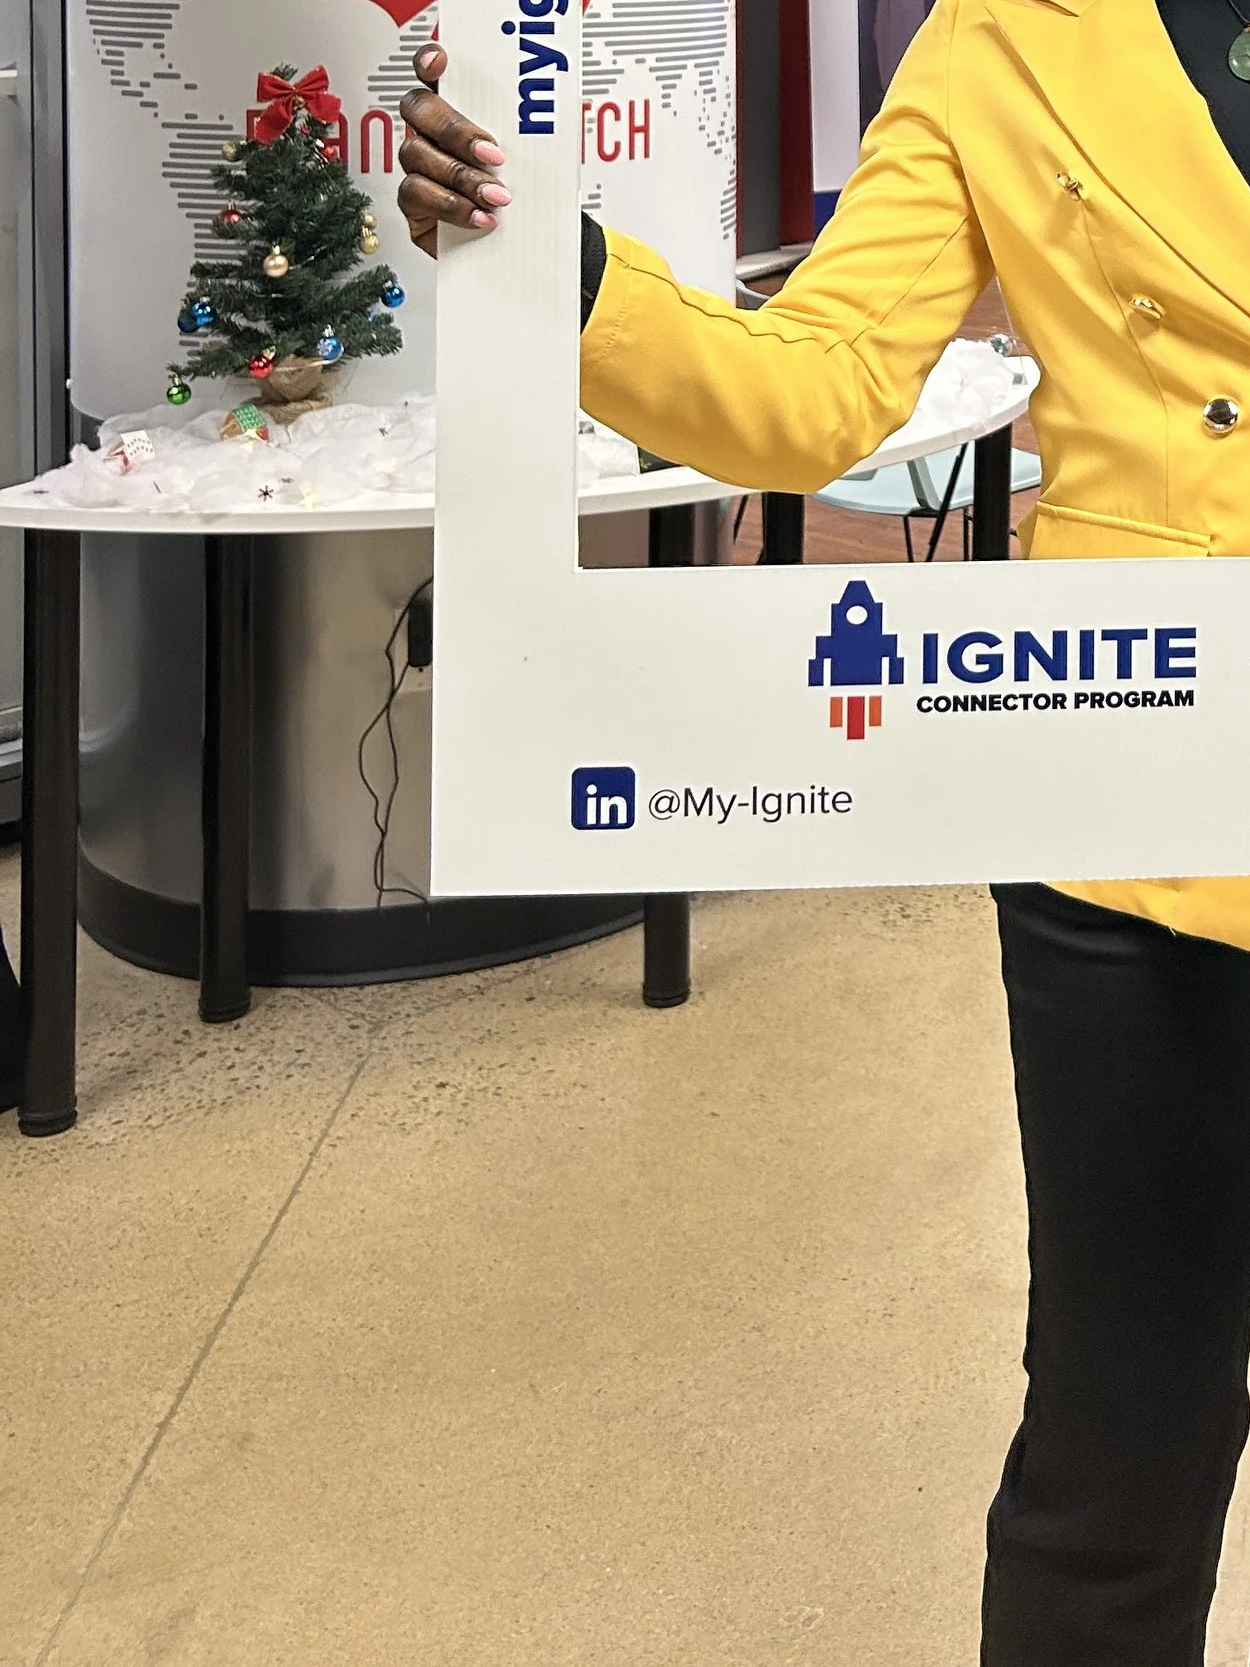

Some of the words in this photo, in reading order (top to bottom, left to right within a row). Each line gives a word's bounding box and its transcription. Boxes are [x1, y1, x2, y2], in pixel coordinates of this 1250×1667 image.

[922, 627, 1197, 685] IGNITE
[916, 692, 1068, 714] CONNECTOR
[1073, 689, 1195, 710] PROGRAM
[586, 784, 628, 825] in
[648, 784, 853, 825] @My-Ignite
